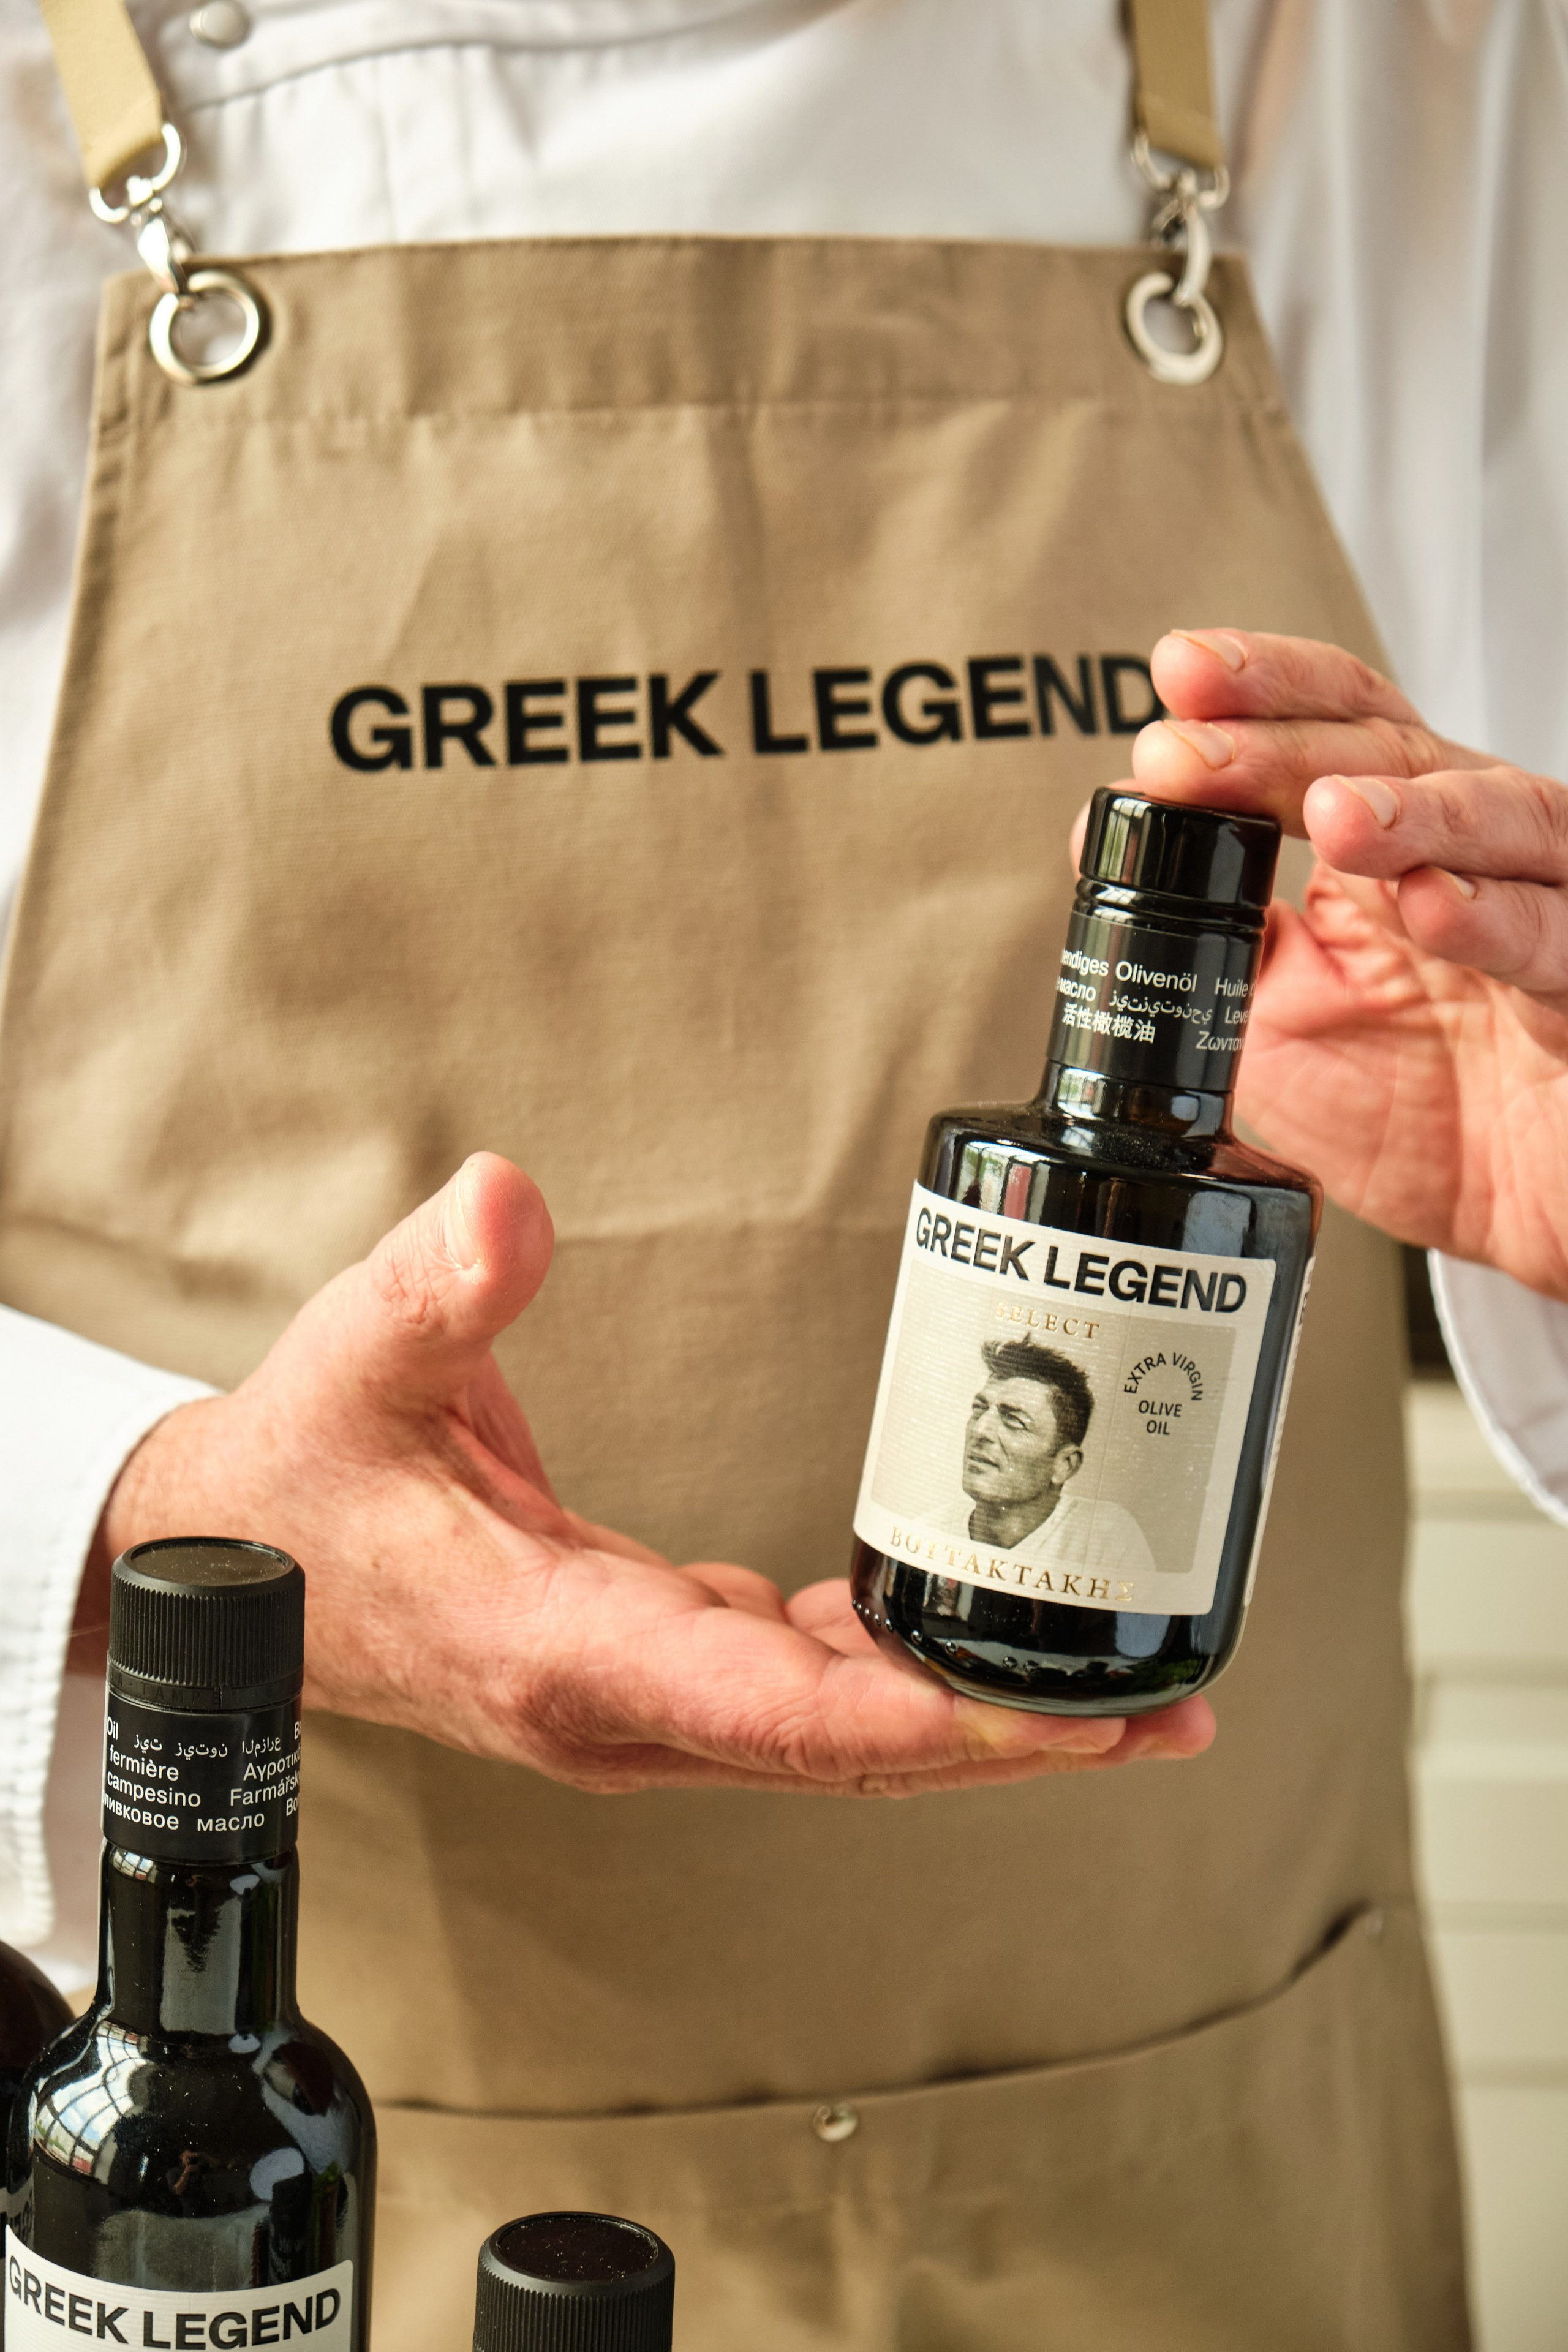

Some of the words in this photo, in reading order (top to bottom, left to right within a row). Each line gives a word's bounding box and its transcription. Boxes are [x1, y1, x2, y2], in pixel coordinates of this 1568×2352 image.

[329, 668, 725, 773] GREEK
[747, 652, 1167, 757] LEGEND
[1115, 960, 1197, 992] Olivenöl
[1215, 977, 1248, 997] Huile
[1061, 1001, 1156, 1044] 活性橄榄油
[916, 1206, 1036, 1281] GREEK
[1043, 1245, 1248, 1314] LEGEND
[995, 1300, 1100, 1339] SELECT
[1123, 1352, 1167, 1394] EXTRA
[1172, 1352, 1204, 1401] VIRGIN
[1139, 1400, 1183, 1418] OLIVE
[1146, 1420, 1170, 1436] OIL
[107, 1716, 119, 1741] Oil
[110, 1744, 179, 1782] fermière
[107, 1771, 201, 1807] campesino
[197, 1812, 265, 1832] масло
[9, 2255, 129, 2345] GREEK
[143, 2288, 341, 2351] LEGEND
